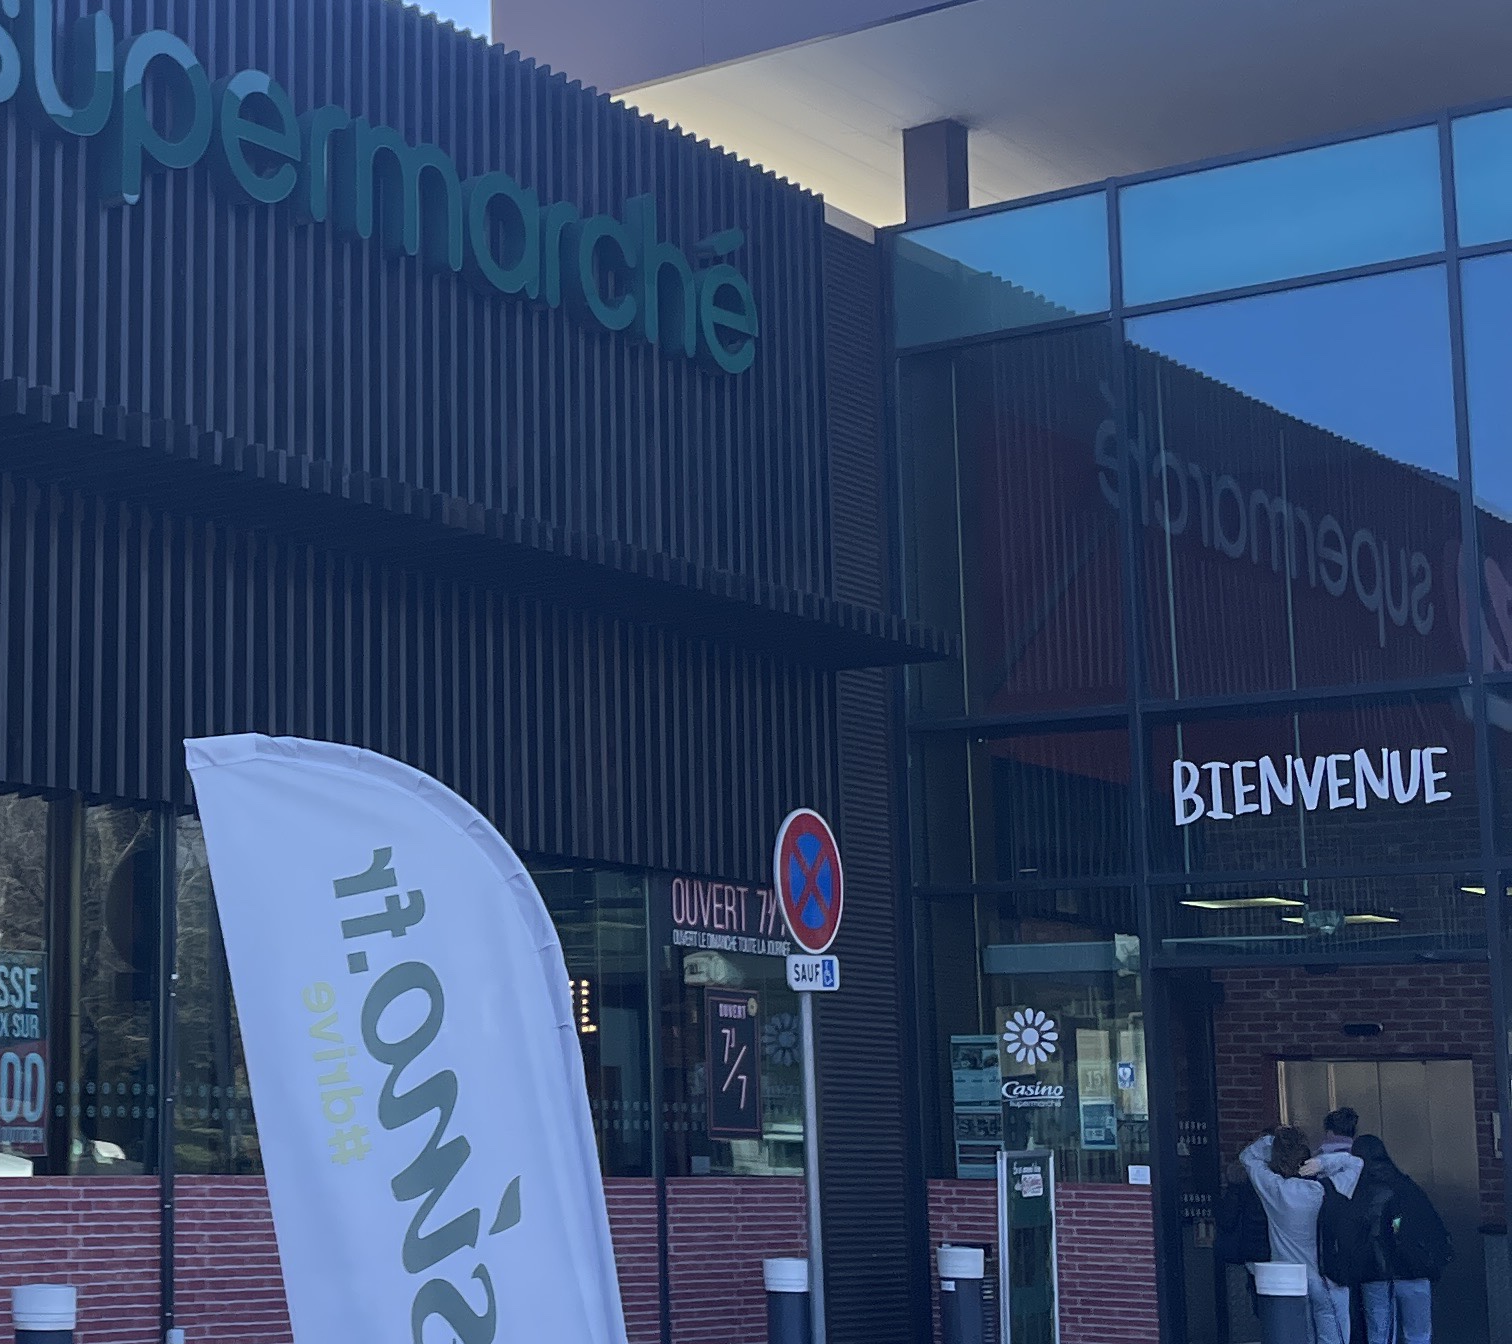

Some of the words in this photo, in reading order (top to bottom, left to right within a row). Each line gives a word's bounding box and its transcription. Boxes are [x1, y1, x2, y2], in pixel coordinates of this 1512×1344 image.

[1173, 746, 1451, 825] BIENVENUE
[672, 877, 749, 932] OUVERT
[793, 963, 820, 982] SAUF
[12, 1013, 40, 1039] SUR
[1001, 1080, 1064, 1099] Casino
